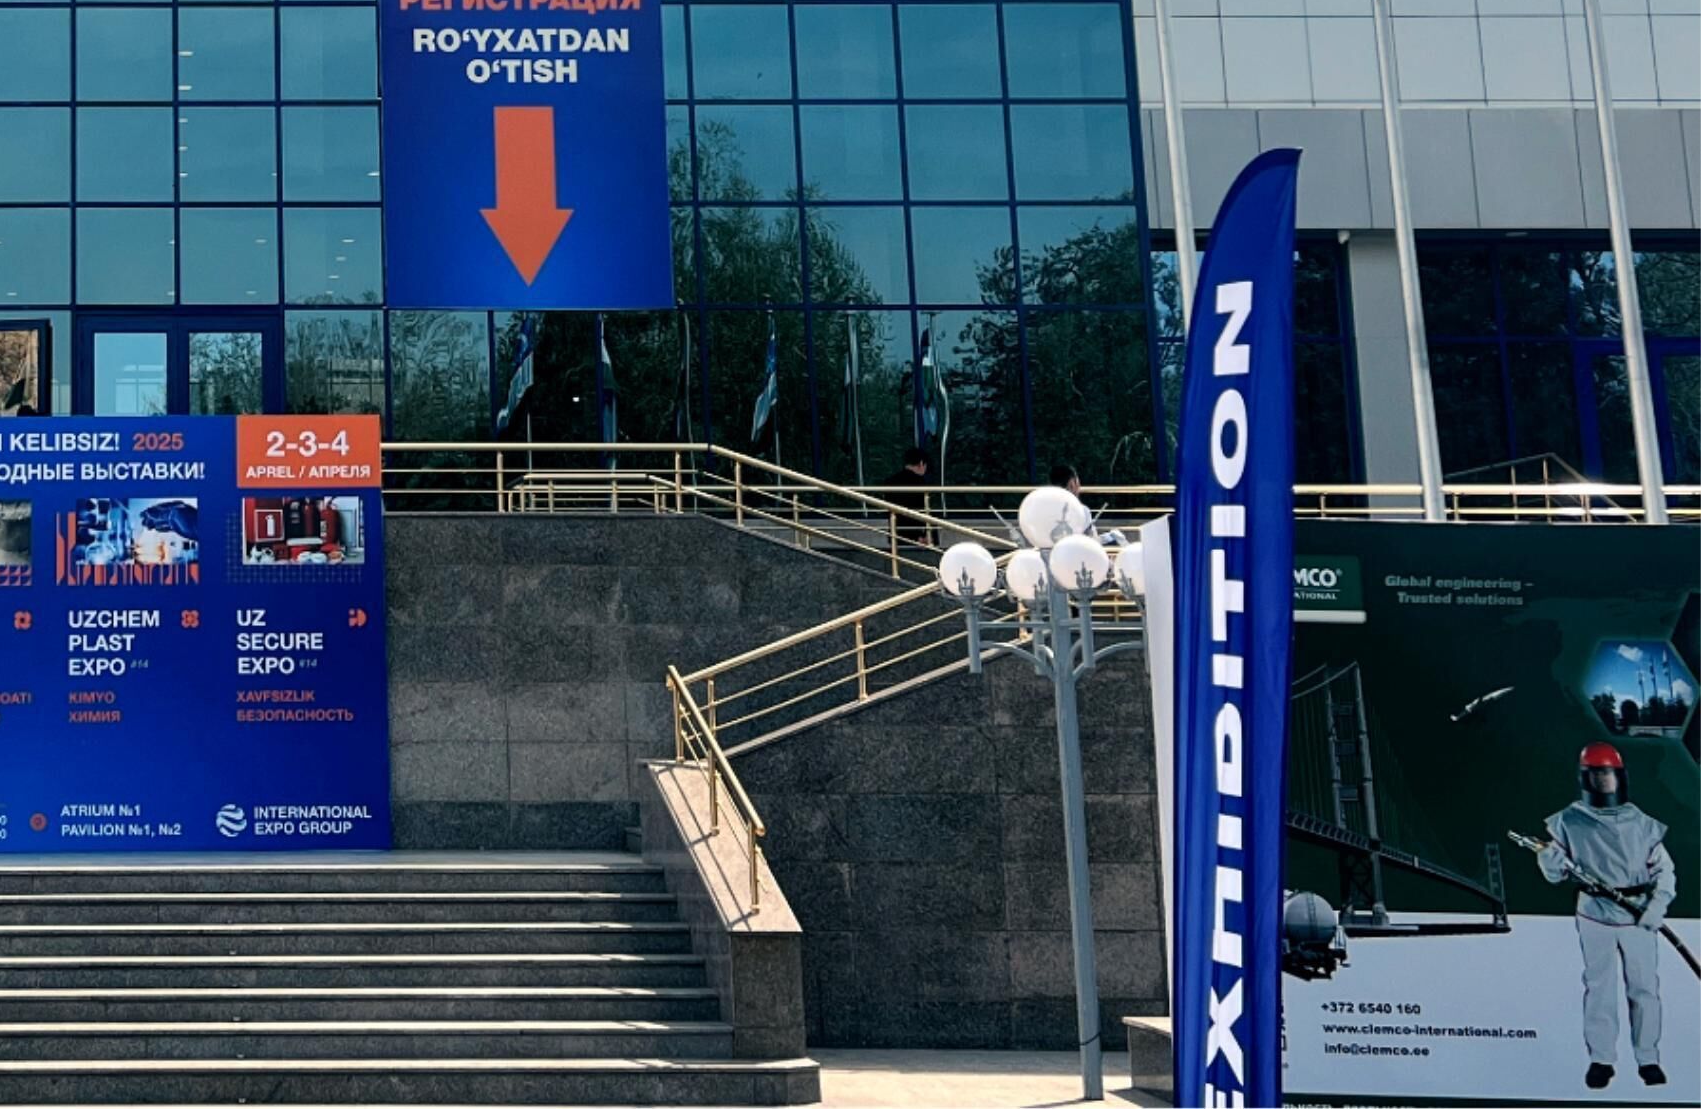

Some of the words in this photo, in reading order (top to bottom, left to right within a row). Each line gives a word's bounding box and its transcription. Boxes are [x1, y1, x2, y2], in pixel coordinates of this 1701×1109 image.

[9, 432, 120, 452] KELIBSIZ!
[132, 432, 185, 452] 2025
[265, 429, 350, 458] 2-3-4
[80, 461, 206, 481] ВЫСТАВКИ!
[245, 465, 296, 480] APREL
[308, 464, 371, 479] АПРЕЛЯ
[1384, 575, 1432, 589] Global
[1435, 577, 1522, 592] engineering
[1397, 592, 1452, 605] Trusted
[1456, 593, 1524, 606] solutions
[68, 610, 161, 628] UZCHEM
[236, 609, 266, 627] UZ
[68, 633, 135, 652] PLAST
[236, 632, 324, 651] SECURE
[68, 657, 126, 676] EXPO
[237, 656, 295, 675] EXPO
[68, 691, 116, 704] KIMYO
[236, 690, 315, 703] XAVFSIZLIK
[68, 710, 121, 723] ХИМИЯ
[236, 708, 354, 722] БЕЗОПАСНОСТЬ
[60, 804, 115, 817] ATRIUM
[253, 805, 372, 819] INTERNATIONAL
[61, 824, 125, 837] PAVILION
[254, 821, 295, 835] EXPO
[298, 821, 353, 835] GROUP
[1321, 1002, 1355, 1014] +372
[1322, 1023, 1538, 1039] www.clemco-international.com
[1324, 1043, 1431, 1058] info@clemco.ee
